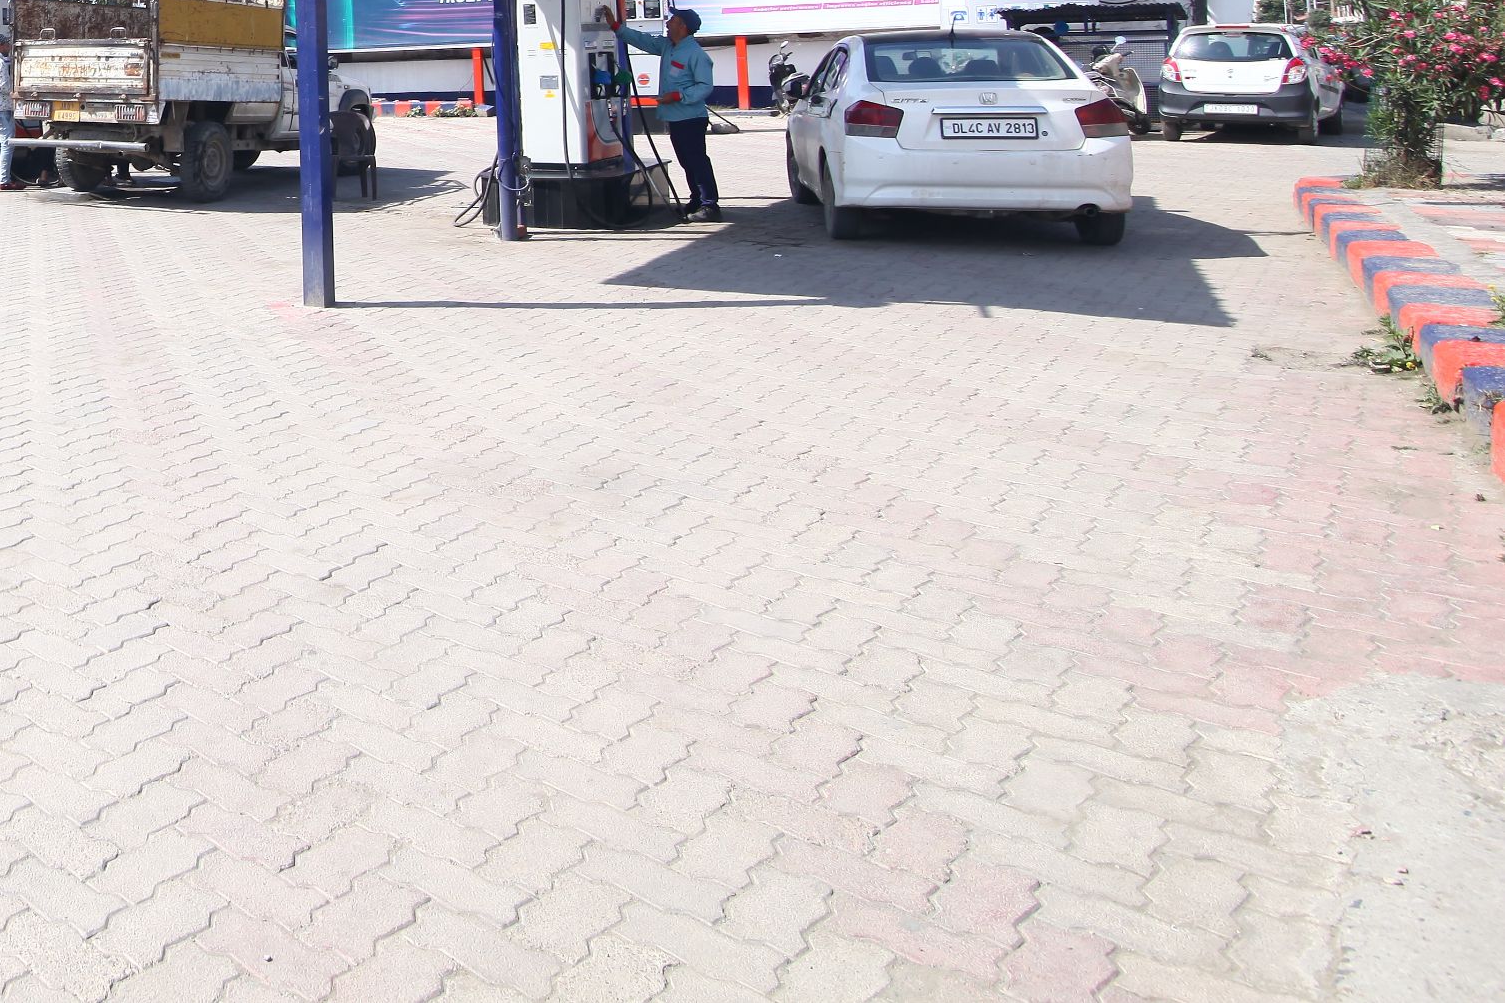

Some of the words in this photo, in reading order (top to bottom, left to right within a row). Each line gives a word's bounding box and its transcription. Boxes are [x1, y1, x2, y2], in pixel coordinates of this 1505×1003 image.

[953, 123, 983, 133] DL4C
[987, 123, 1000, 133] AV
[1006, 123, 1034, 133] 2813
